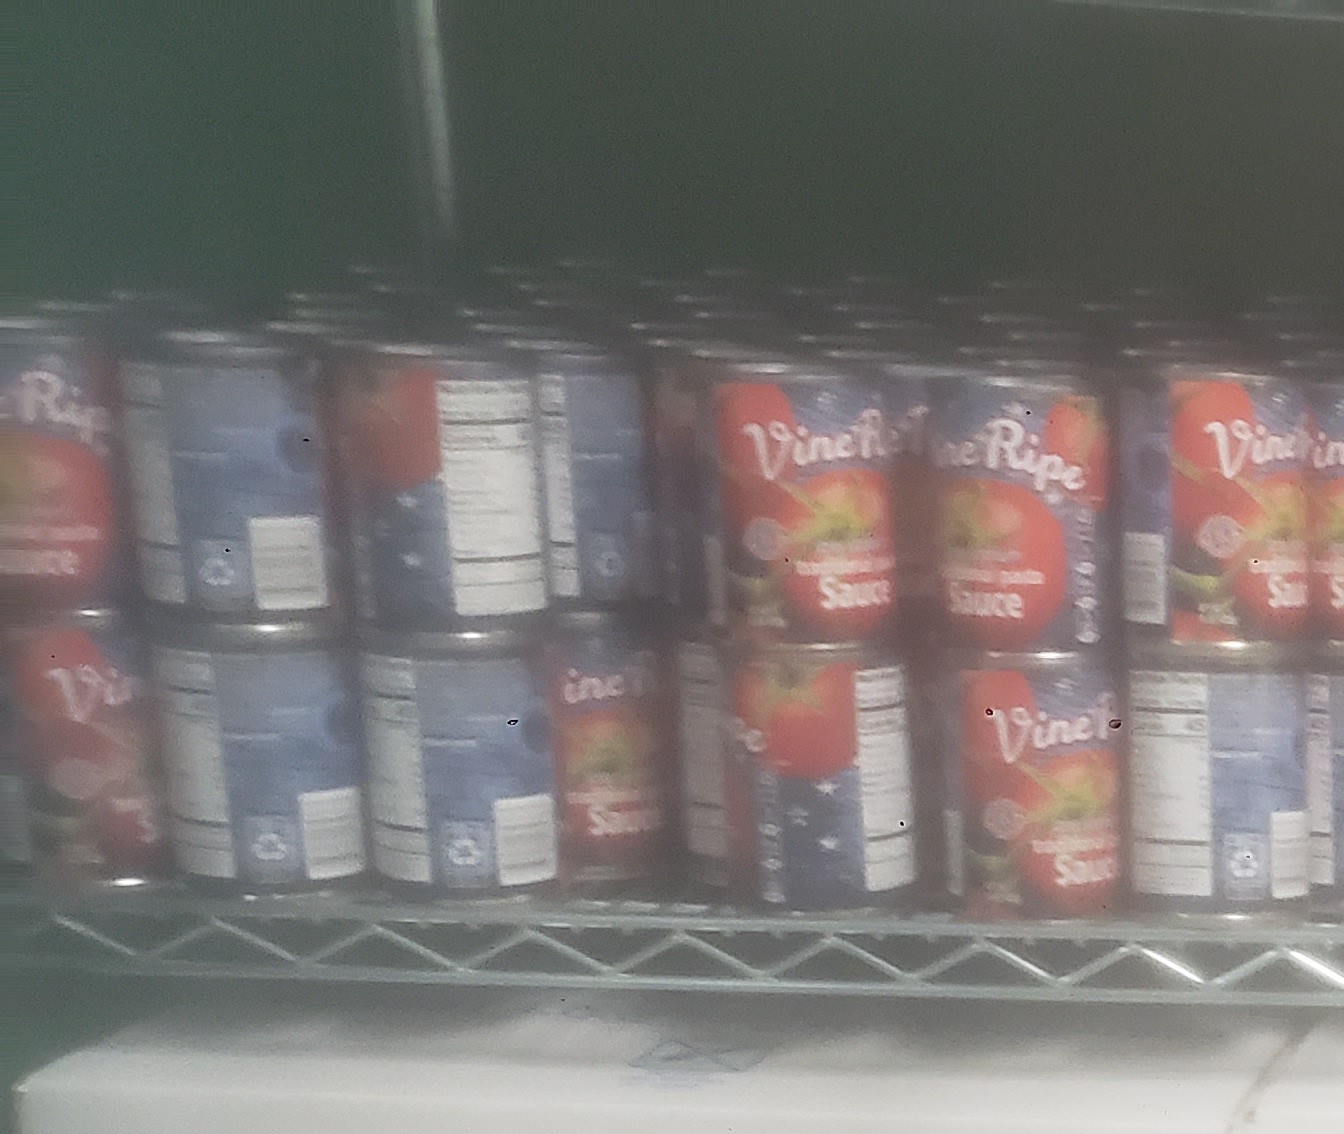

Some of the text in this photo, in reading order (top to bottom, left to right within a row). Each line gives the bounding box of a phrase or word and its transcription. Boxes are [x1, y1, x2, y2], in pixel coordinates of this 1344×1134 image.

[743, 419, 853, 480] Vine
[976, 418, 1086, 492] Ripe
[986, 706, 1094, 763] Vine
